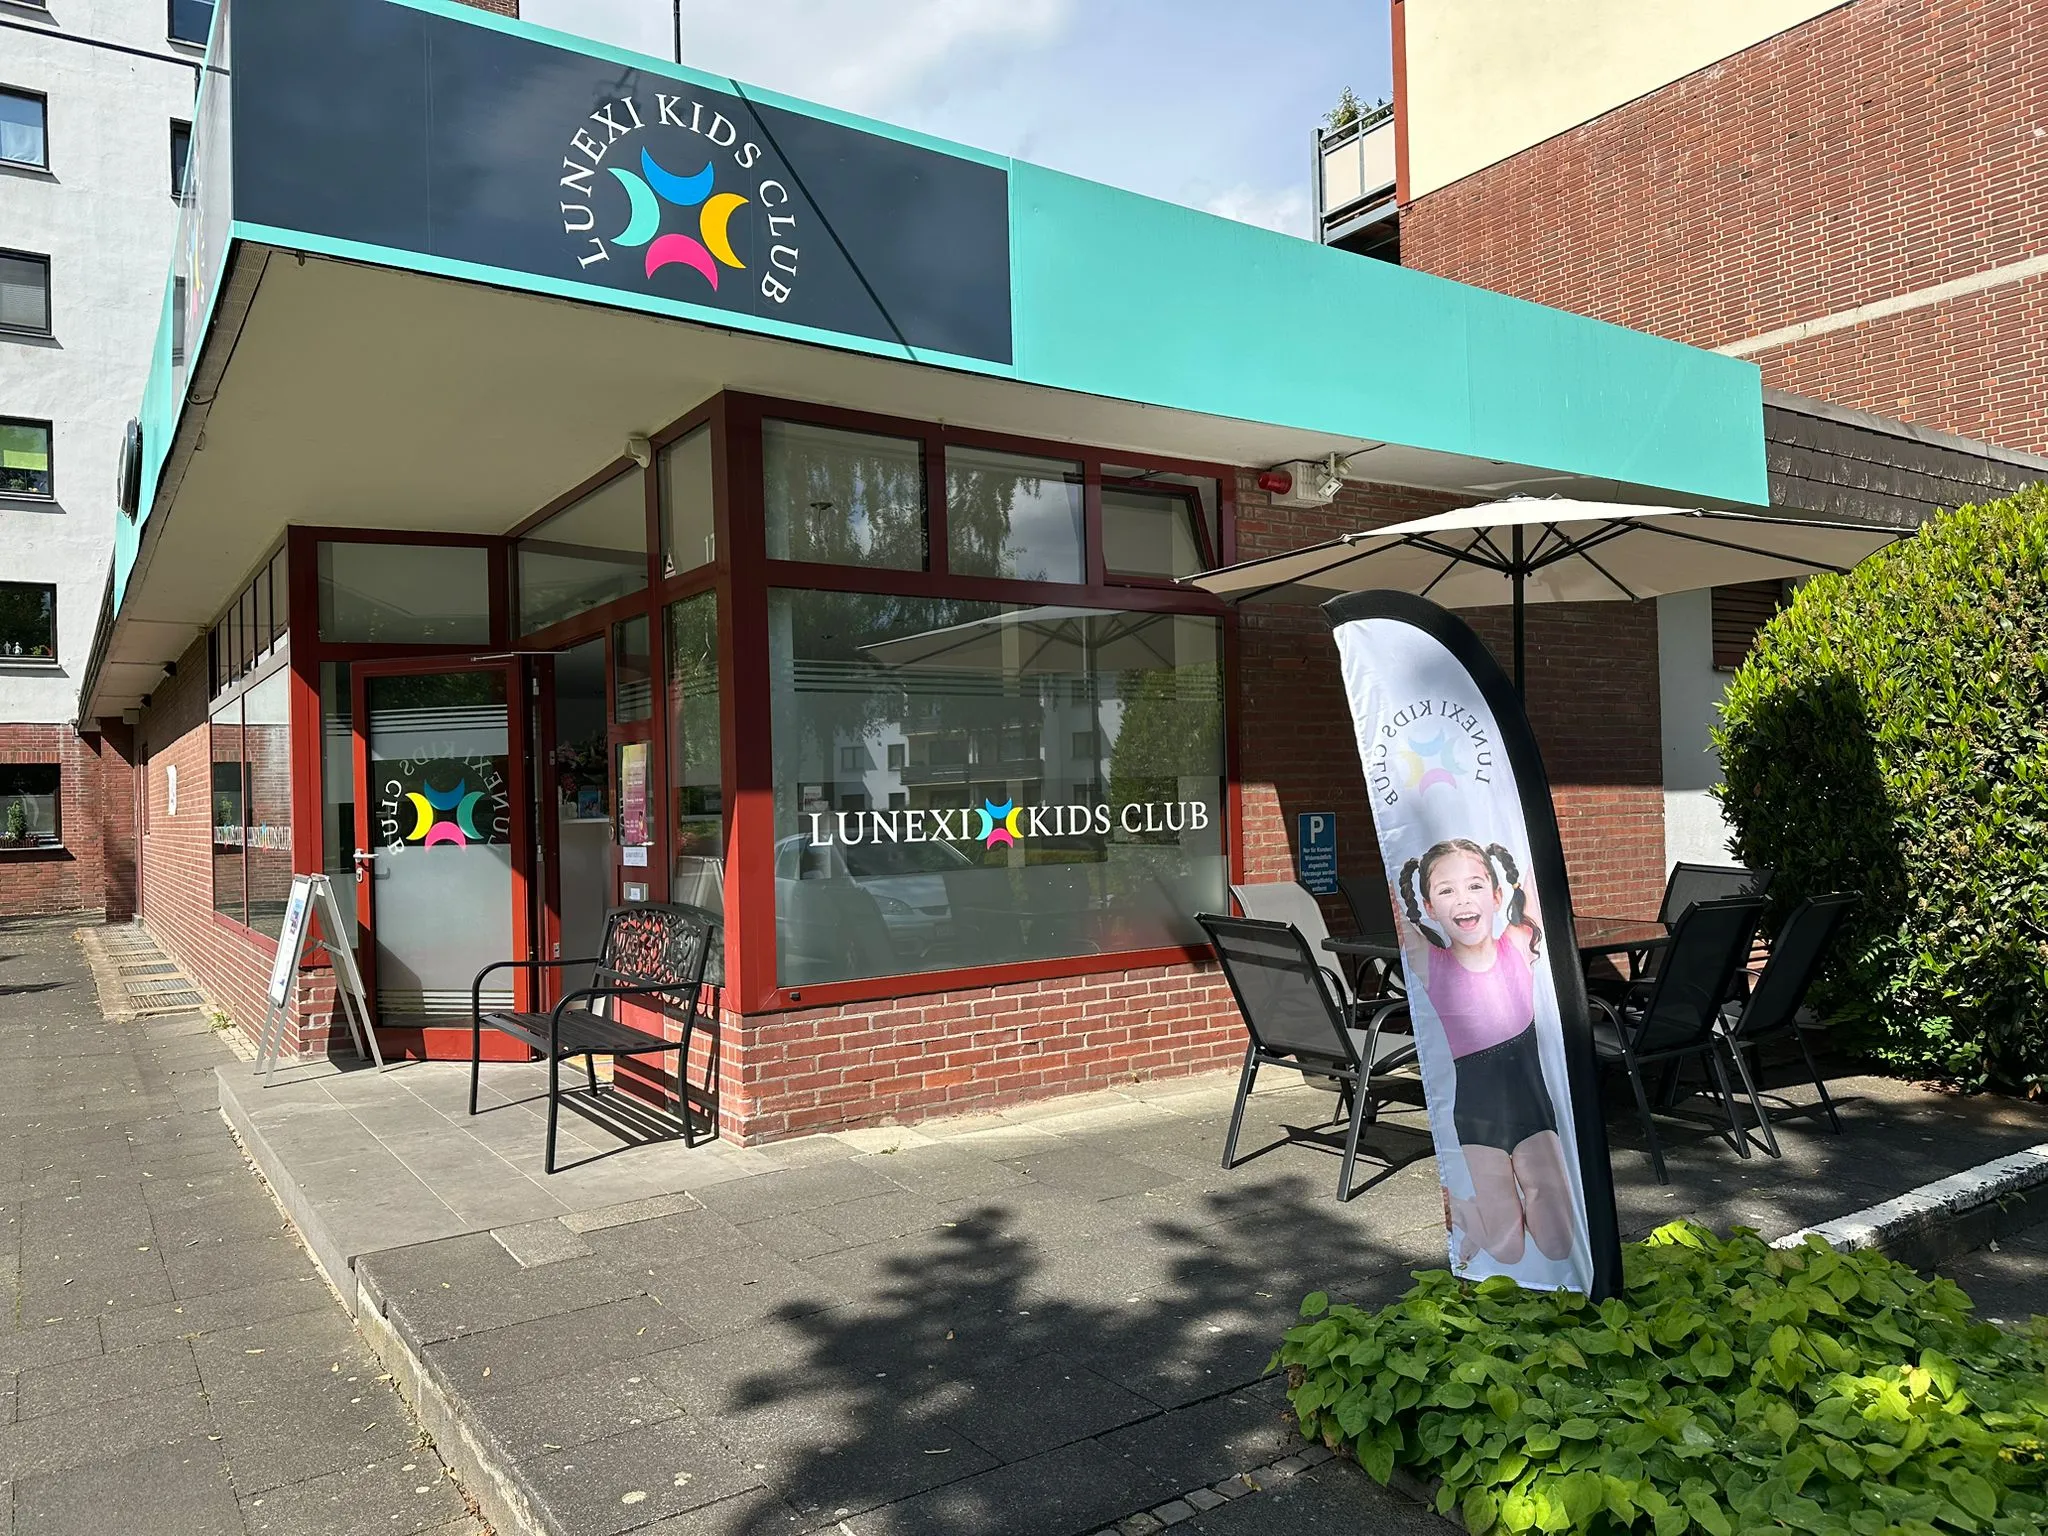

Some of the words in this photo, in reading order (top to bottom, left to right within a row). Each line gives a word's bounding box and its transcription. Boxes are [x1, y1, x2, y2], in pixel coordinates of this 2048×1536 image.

[560, 96, 646, 270] LUNEXI
[655, 93, 762, 169] KIDS
[759, 179, 799, 304] CLUB
[809, 808, 971, 848] LUNEXI
[1028, 803, 1112, 838] KIDS
[1120, 800, 1210, 834] CLUB
[1310, 815, 1324, 844] P
